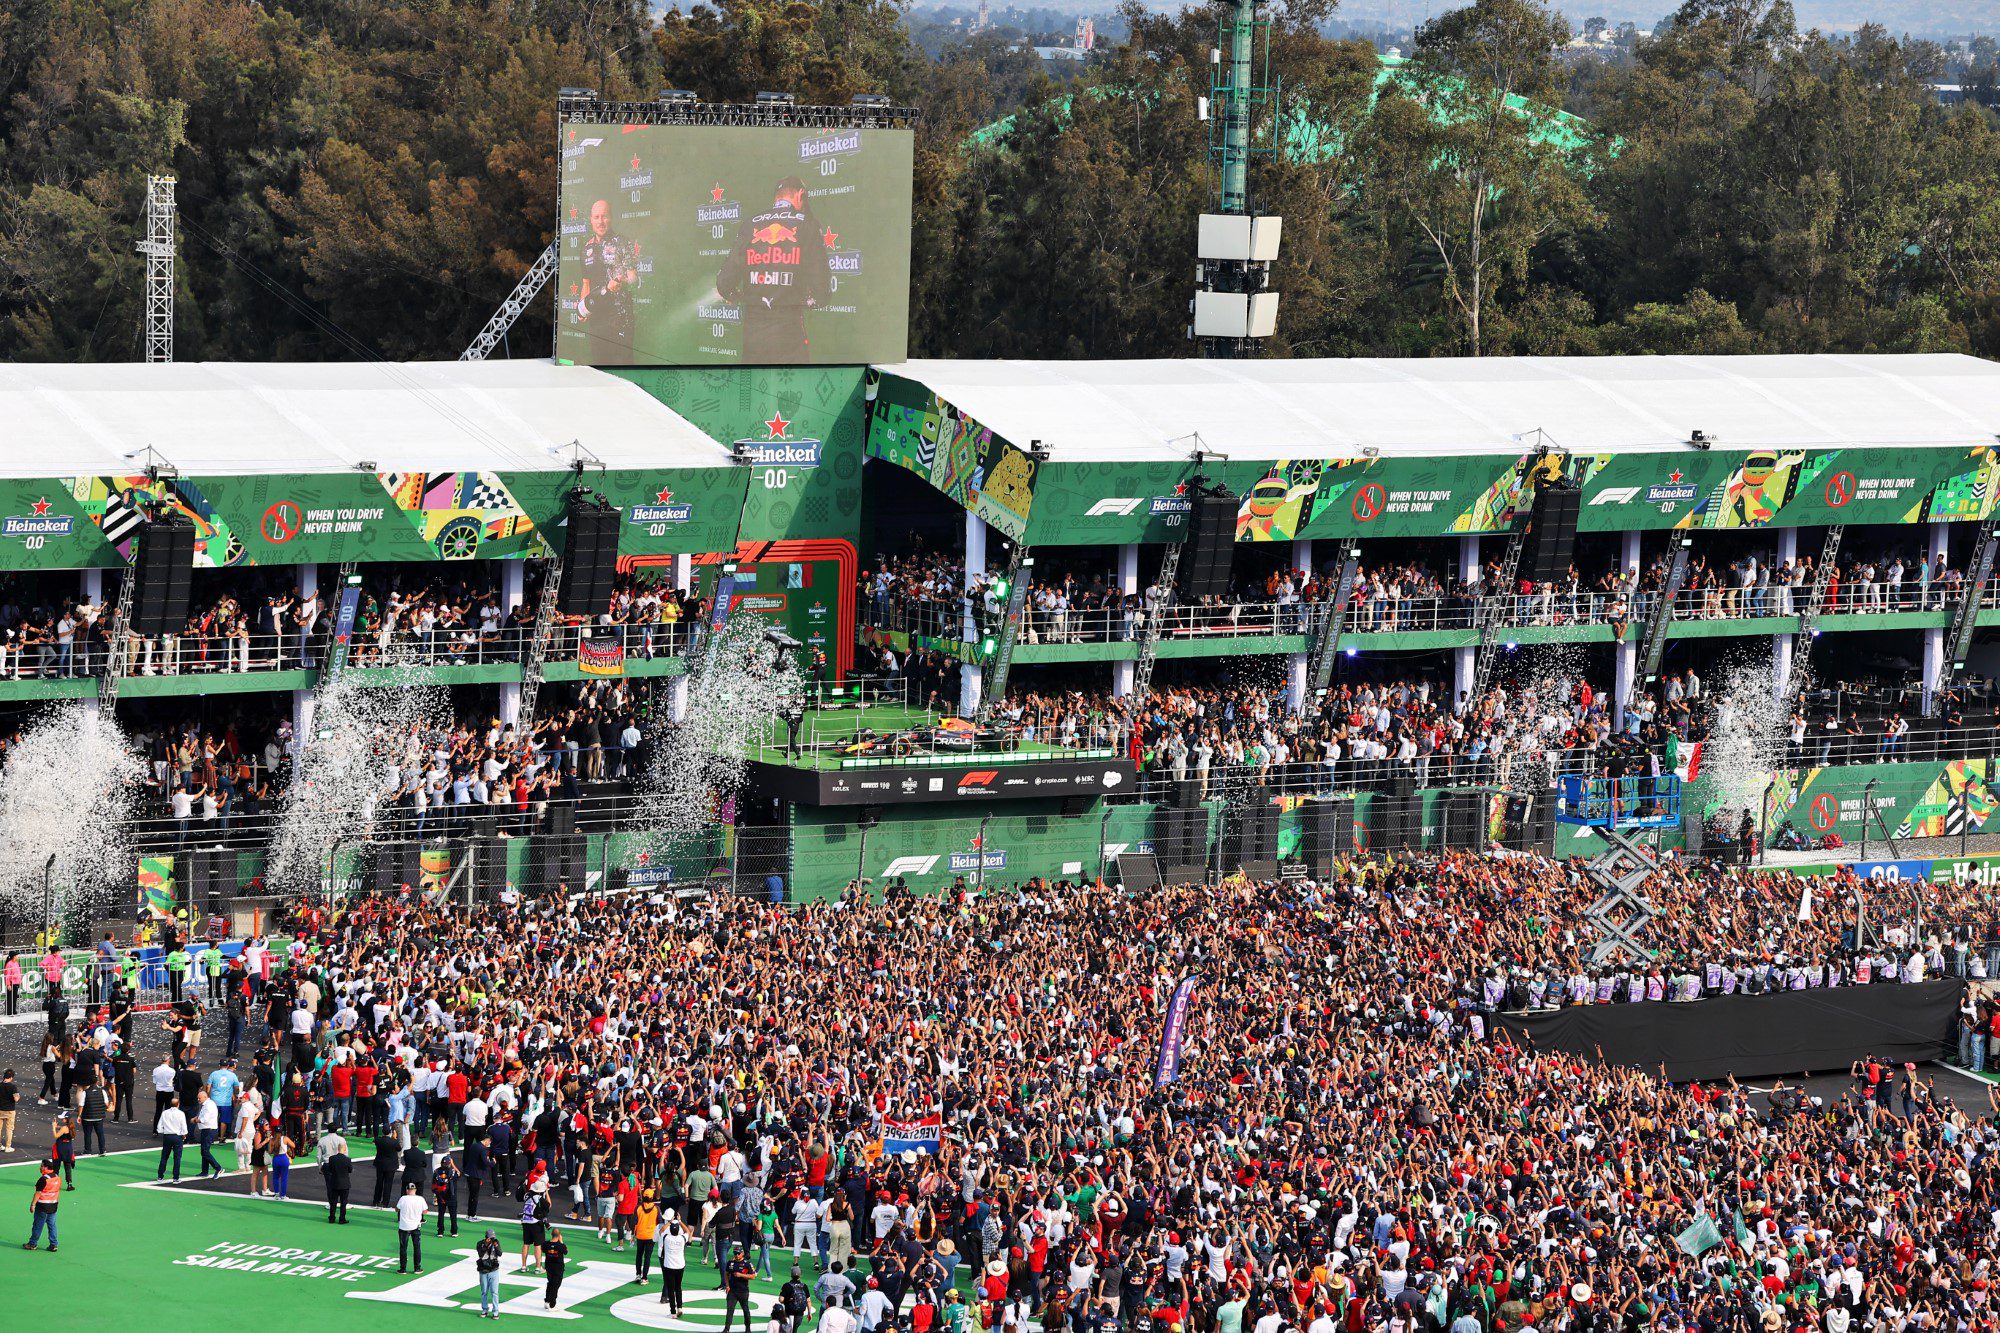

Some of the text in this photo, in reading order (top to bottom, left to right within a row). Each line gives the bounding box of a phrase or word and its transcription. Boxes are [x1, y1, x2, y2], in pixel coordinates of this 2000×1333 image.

[801, 133, 859, 157] Heineken
[820, 158, 836, 176] 0.0
[698, 206, 739, 221] Heineken
[752, 211, 805, 222] ORACLE
[712, 224, 724, 238] 0.0
[747, 247, 800, 265] Red Bull
[750, 271, 779, 285] Mobil
[699, 306, 739, 319] Heineken
[712, 324, 724, 337] 0.0
[765, 469, 787, 489] 0.0
[1859, 478, 1915, 488] WHEN YOU DRIVE
[1390, 490, 1451, 501] WHEN YOU DRIVE
[1649, 487, 1693, 498] Heineken
[1855, 490, 1899, 499] NEVER DRINK
[633, 508, 688, 519] Heineken
[1386, 502, 1433, 512] NEVER DRINK
[1661, 502, 1675, 513] 0.0
[307, 508, 384, 520] WHEN YOU DRIVE
[1166, 514, 1181, 526] 0.0
[6, 520, 69, 532] Heineken
[304, 522, 363, 533] NEVER DRINK
[650, 523, 666, 536] 0.0
[26, 536, 44, 549] 0.0
[1961, 592, 1981, 643] Heineken
[1650, 603, 1672, 655] Heineken
[1321, 615, 1341, 669] Heineken
[995, 625, 1015, 683] Heineken
[934, 737, 972, 745] ORACLE
[1841, 799, 1860, 810] WHEN
[1876, 797, 1896, 807] DRIVE
[1840, 810, 1860, 821] NEVER
[220, 1077, 227, 1086] 2
[205, 1241, 400, 1268] HIDRATATE
[172, 1254, 376, 1281] SANAMENTE
